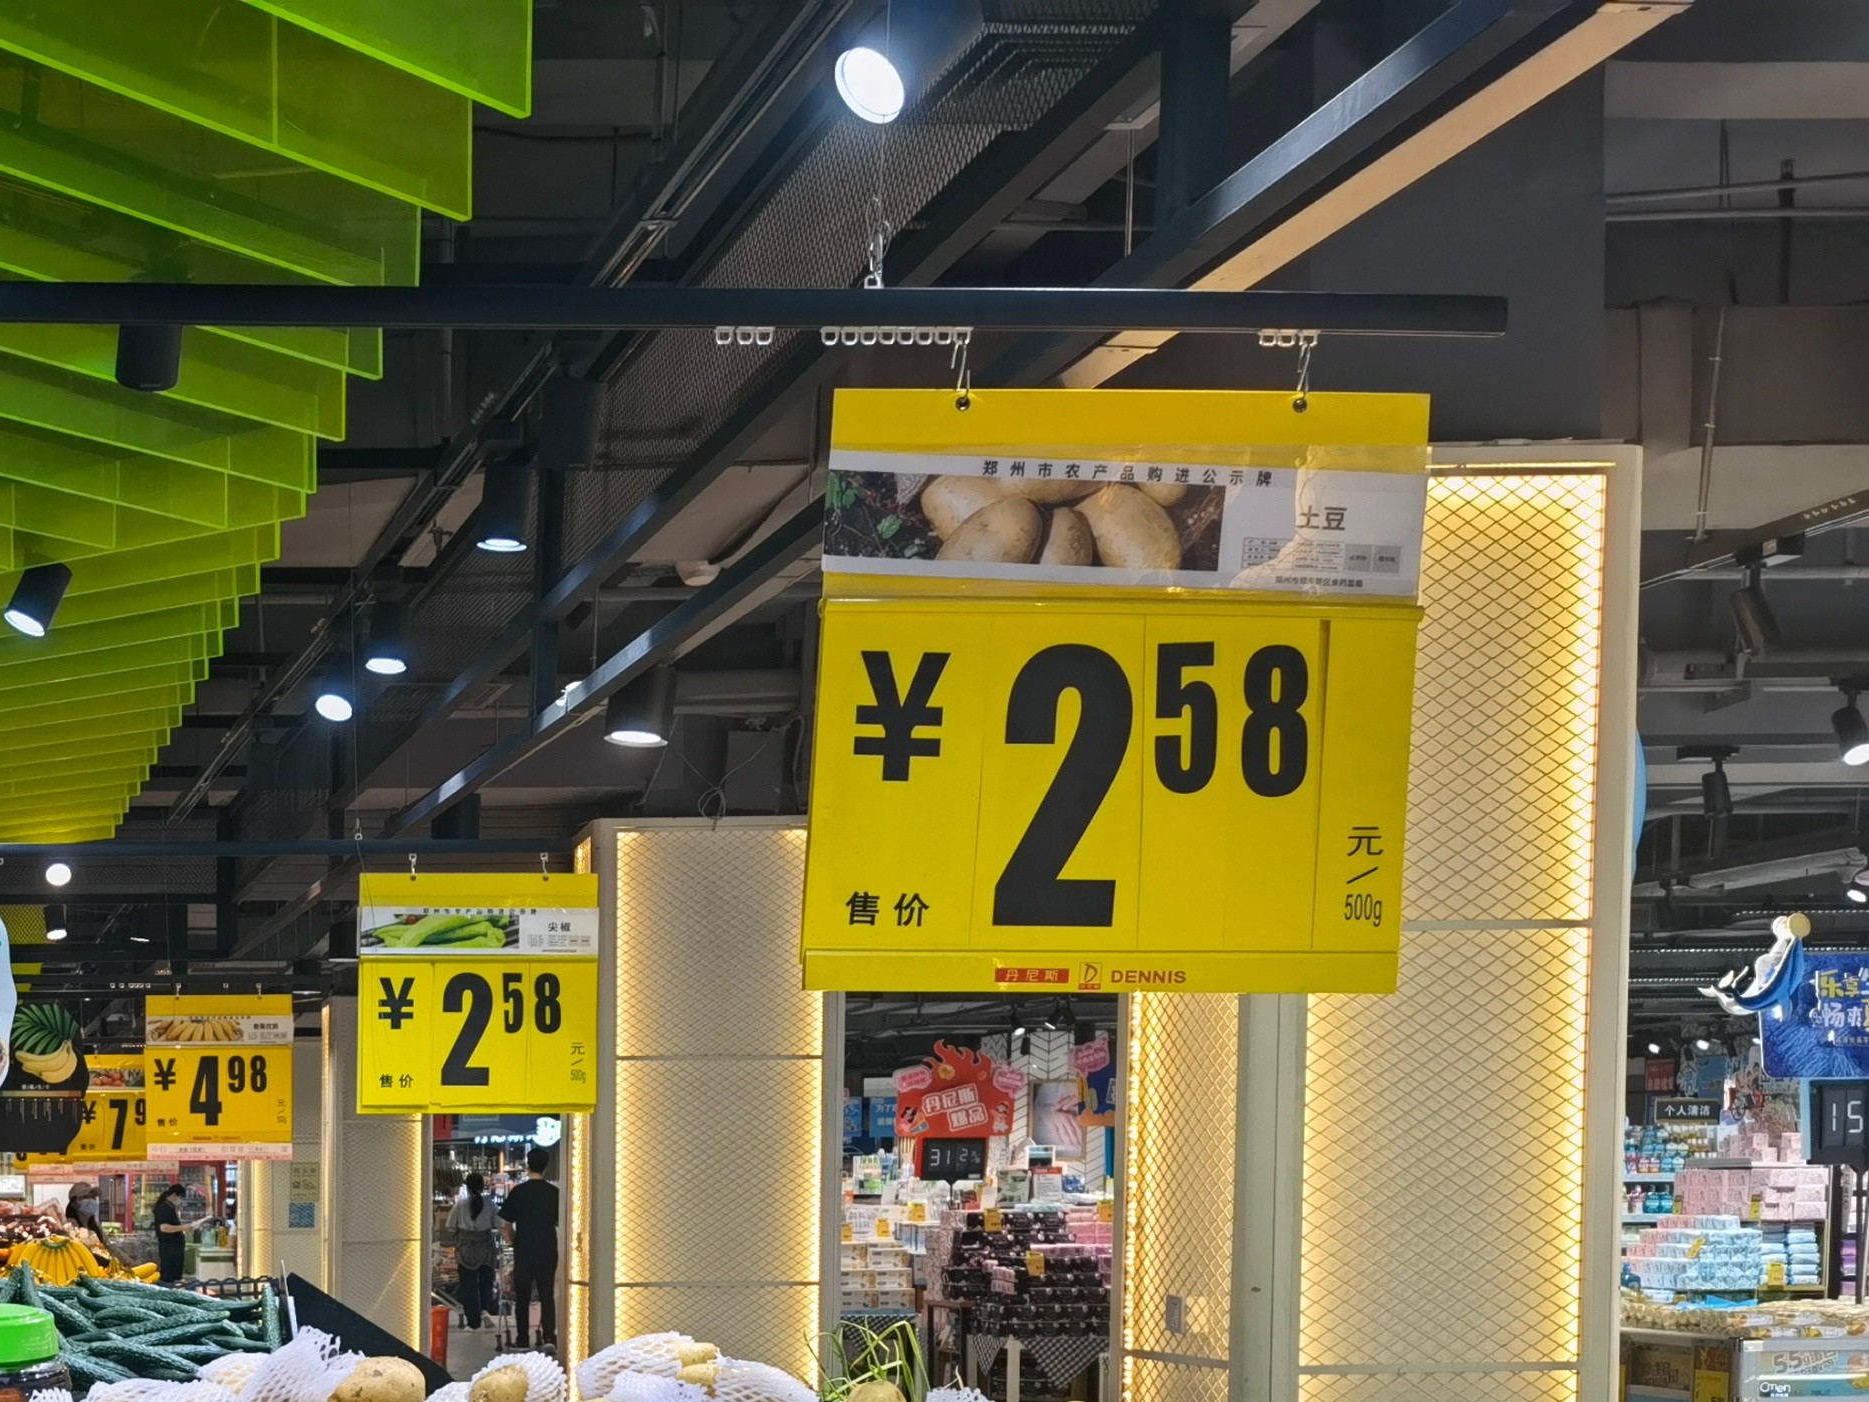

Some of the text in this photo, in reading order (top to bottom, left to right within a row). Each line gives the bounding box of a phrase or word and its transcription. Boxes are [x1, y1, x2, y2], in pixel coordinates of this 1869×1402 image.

[982, 460, 1274, 488] 郑州市农产品购进公示牌
[1296, 505, 1347, 531] 土豆
[1348, 827, 1383, 856] 元
[846, 892, 929, 926] 售价
[1344, 894, 1382, 927] 500g
[548, 922, 571, 932] 尖椒
[1005, 970, 1059, 982] 丹尼斯
[1110, 970, 1187, 984] DENNIS
[571, 1043, 585, 1055] 元
[379, 1073, 414, 1088] 售价
[1665, 1104, 1711, 1116] 个人清洁
